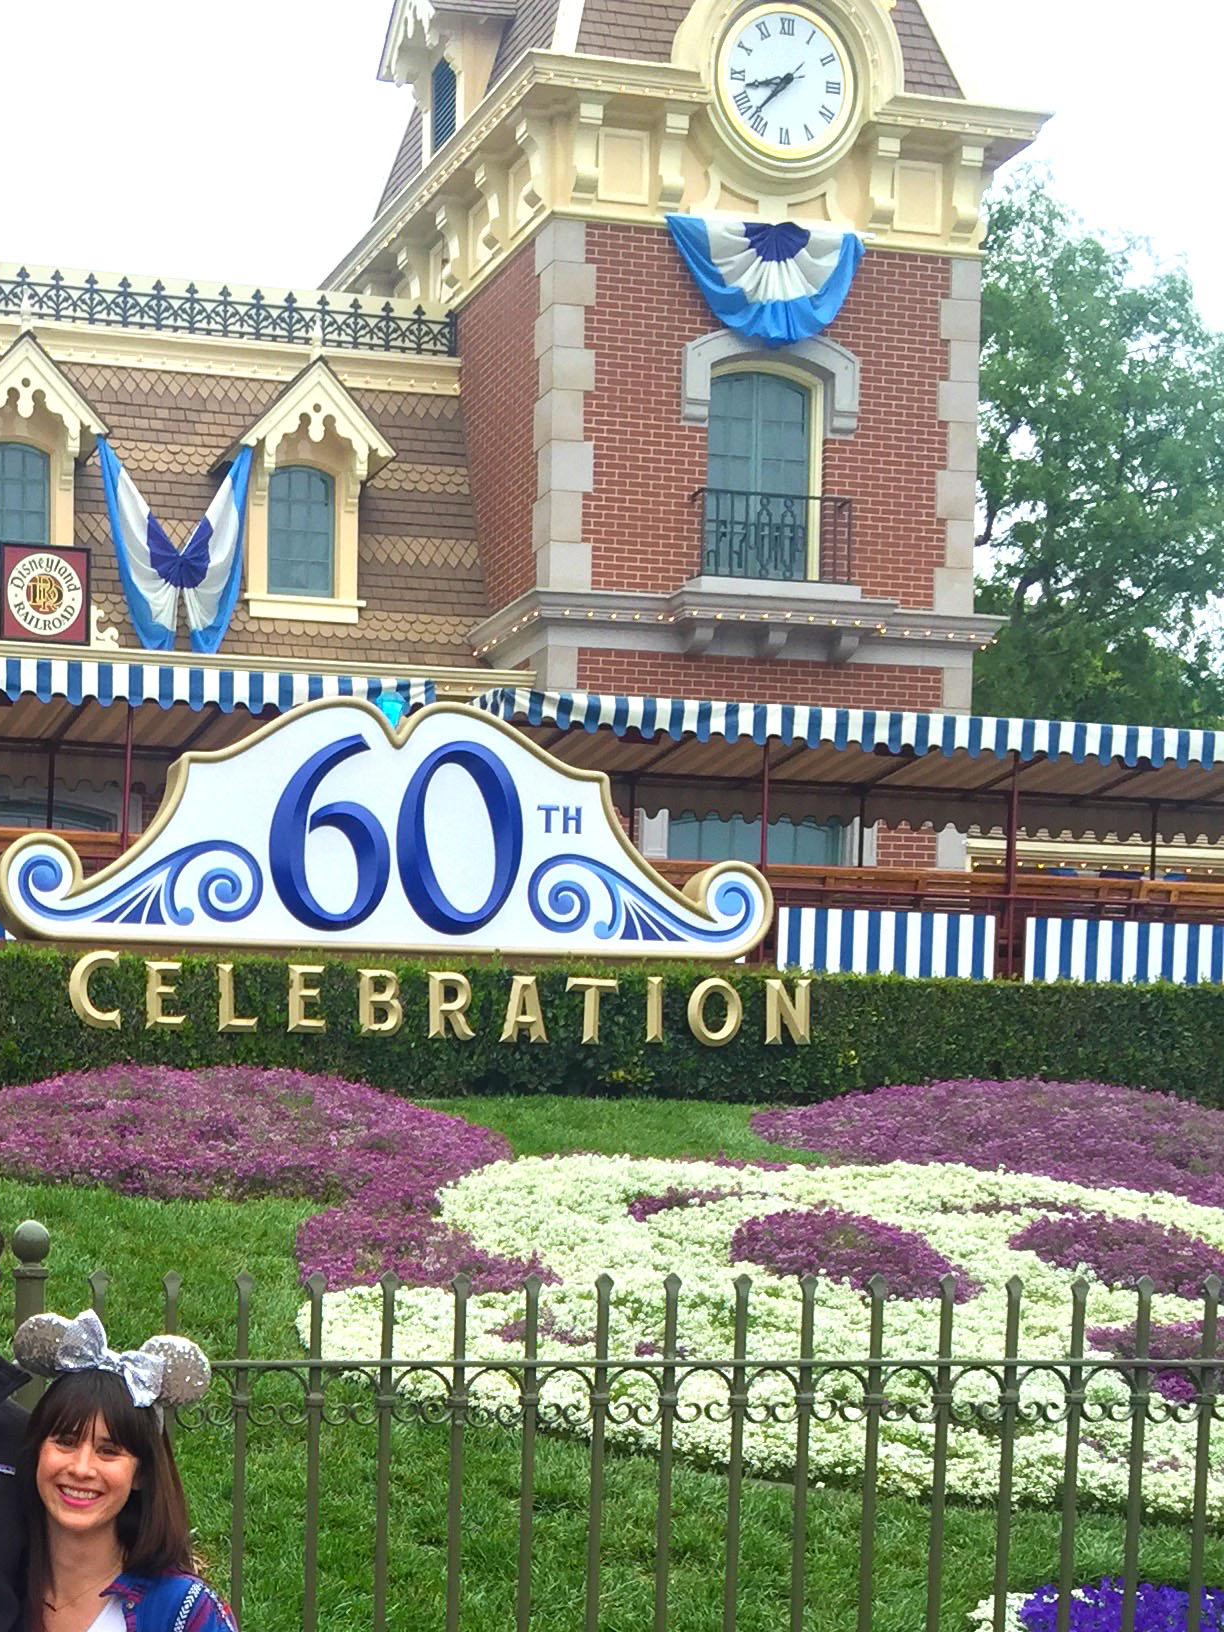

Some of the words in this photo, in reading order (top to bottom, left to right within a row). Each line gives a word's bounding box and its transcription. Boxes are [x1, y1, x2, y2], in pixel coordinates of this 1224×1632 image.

[755, 21, 771, 41] XI
[779, 17, 795, 36] XII
[806, 30, 816, 45] I
[737, 41, 752, 56] X
[820, 53, 835, 67] II
[730, 67, 745, 82] IX
[826, 81, 841, 95] III
[733, 90, 753, 116] VIII
[819, 104, 835, 124] IV
[750, 114, 768, 137] VII
[804, 124, 814, 141] V
[779, 127, 791, 145] VI
[10, 557, 81, 592] Disneyland
[14, 601, 76, 631] RAILROAD
[269, 733, 523, 934] 60
[537, 804, 583, 835] TH
[68, 950, 812, 1048] CELEBRATION
